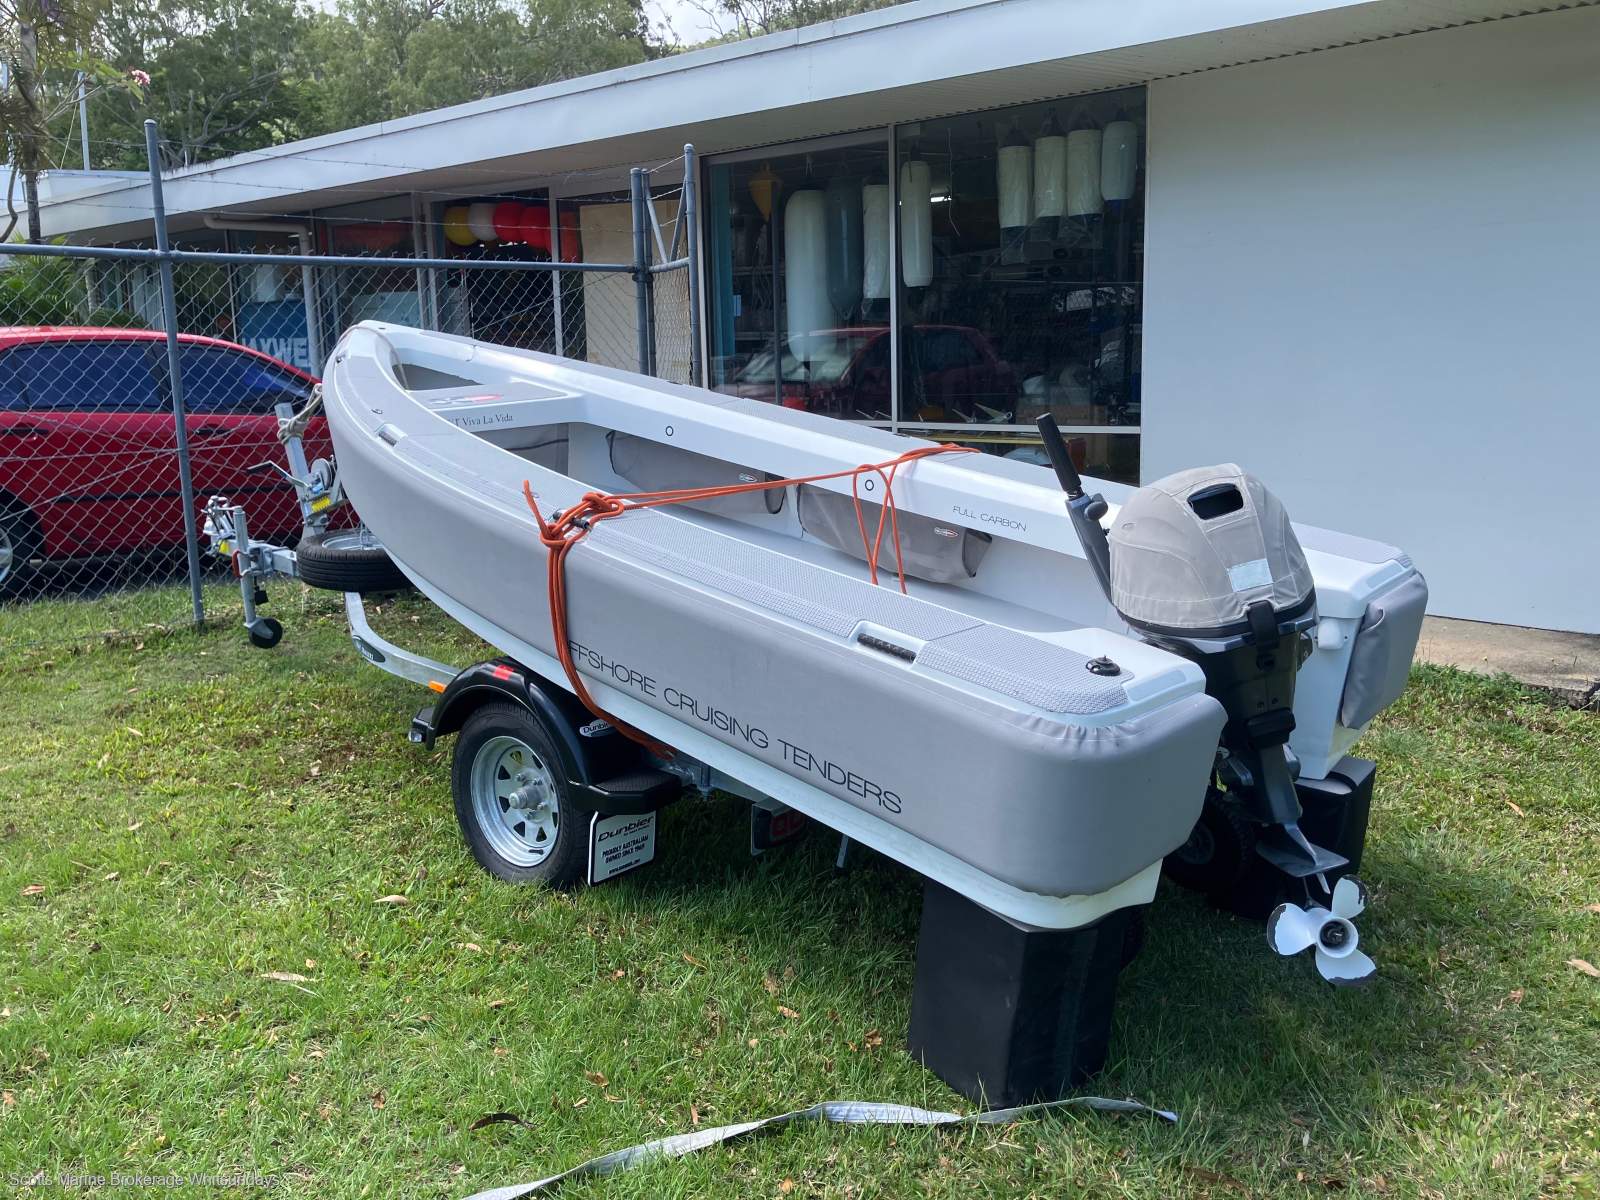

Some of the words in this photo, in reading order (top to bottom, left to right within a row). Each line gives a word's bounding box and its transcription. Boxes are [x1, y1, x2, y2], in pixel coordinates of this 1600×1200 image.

[462, 416, 481, 426] Viva
[483, 415, 494, 425] La
[495, 412, 513, 423] Vida
[953, 505, 977, 519] FULL
[980, 513, 1027, 532] CARBON
[569, 639, 657, 697] FFSHORE
[663, 687, 769, 749] CRUISING
[777, 738, 902, 814] TENDERS
[598, 816, 654, 841] Dunbier
